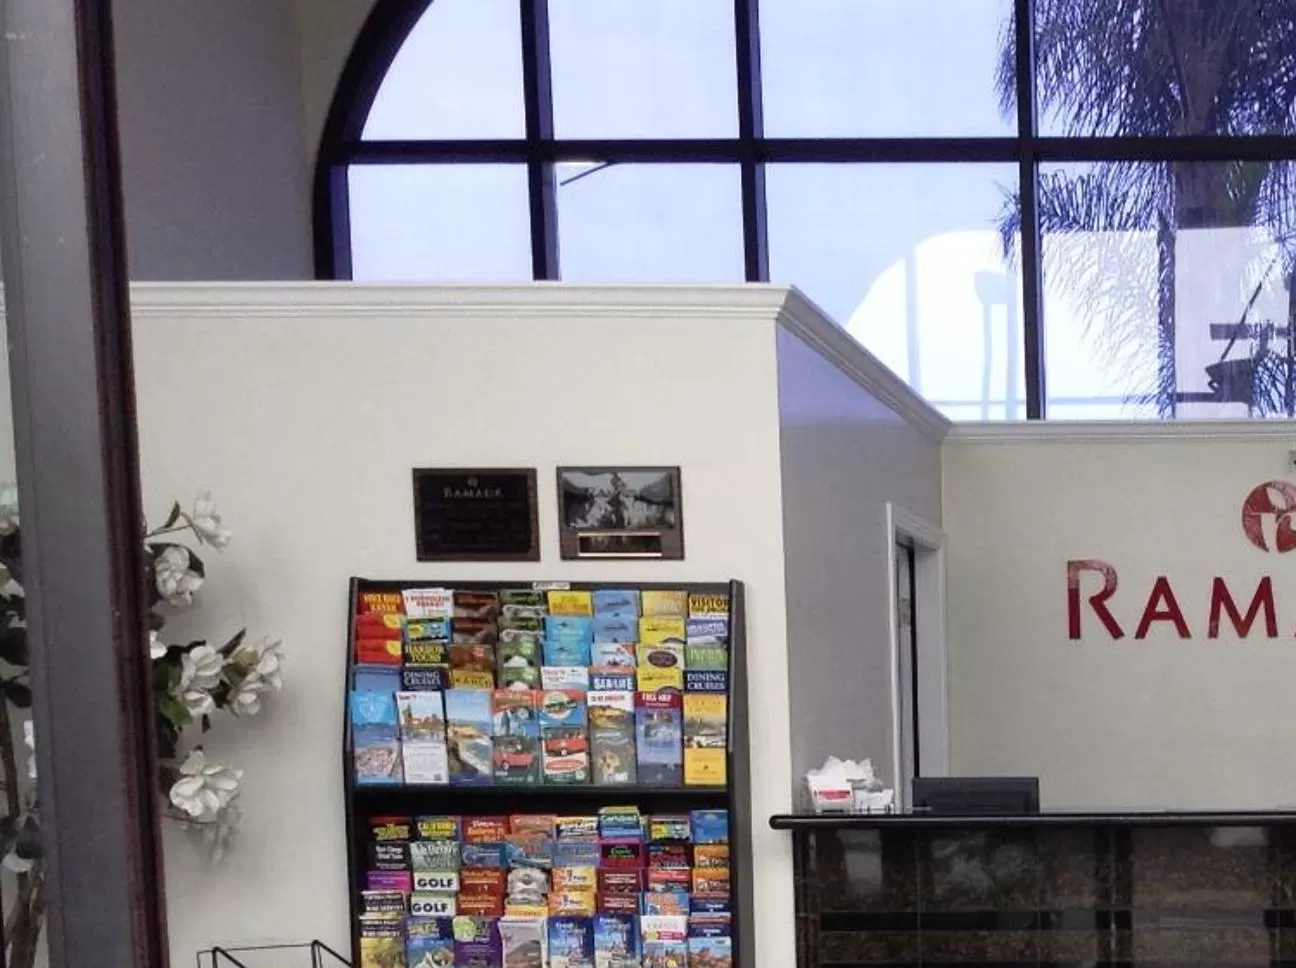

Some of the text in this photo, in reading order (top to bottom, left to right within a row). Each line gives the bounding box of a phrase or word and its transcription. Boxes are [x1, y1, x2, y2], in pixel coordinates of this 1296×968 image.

[687, 673, 725, 682] DINING
[687, 681, 726, 690] CRUISES
[417, 878, 455, 889] GOLF
[412, 902, 449, 913] GOLF
